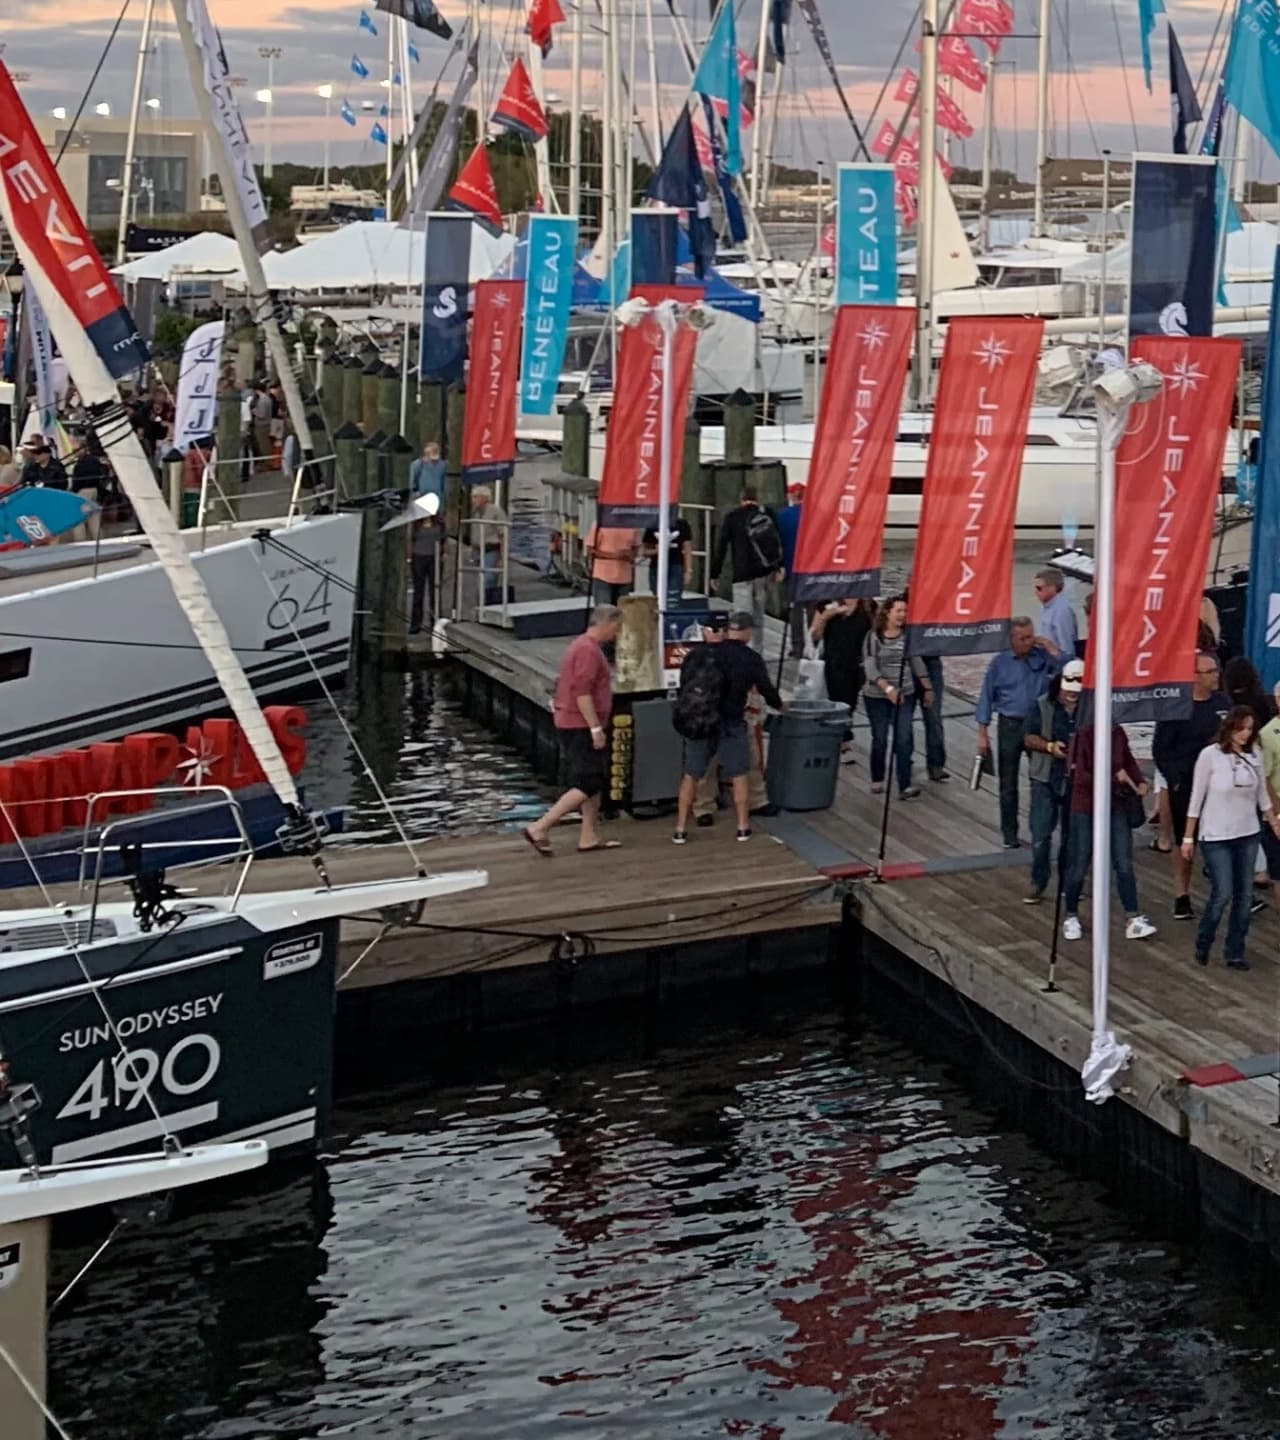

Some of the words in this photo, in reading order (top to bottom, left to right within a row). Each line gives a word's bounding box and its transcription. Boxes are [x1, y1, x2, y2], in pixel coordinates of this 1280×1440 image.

[526, 231, 562, 401] BENETEAU
[858, 187, 883, 300] TEAU
[635, 331, 666, 499] JEANNEAU
[832, 364, 878, 564] JEANNEAU
[954, 386, 999, 616] JEANNEAU
[1135, 415, 1190, 678] JEANNEAU
[266, 574, 334, 631] 64
[56, 1032, 221, 1122] 490
[59, 1026, 111, 1053] SUN
[117, 993, 224, 1037] ODYSSEY
